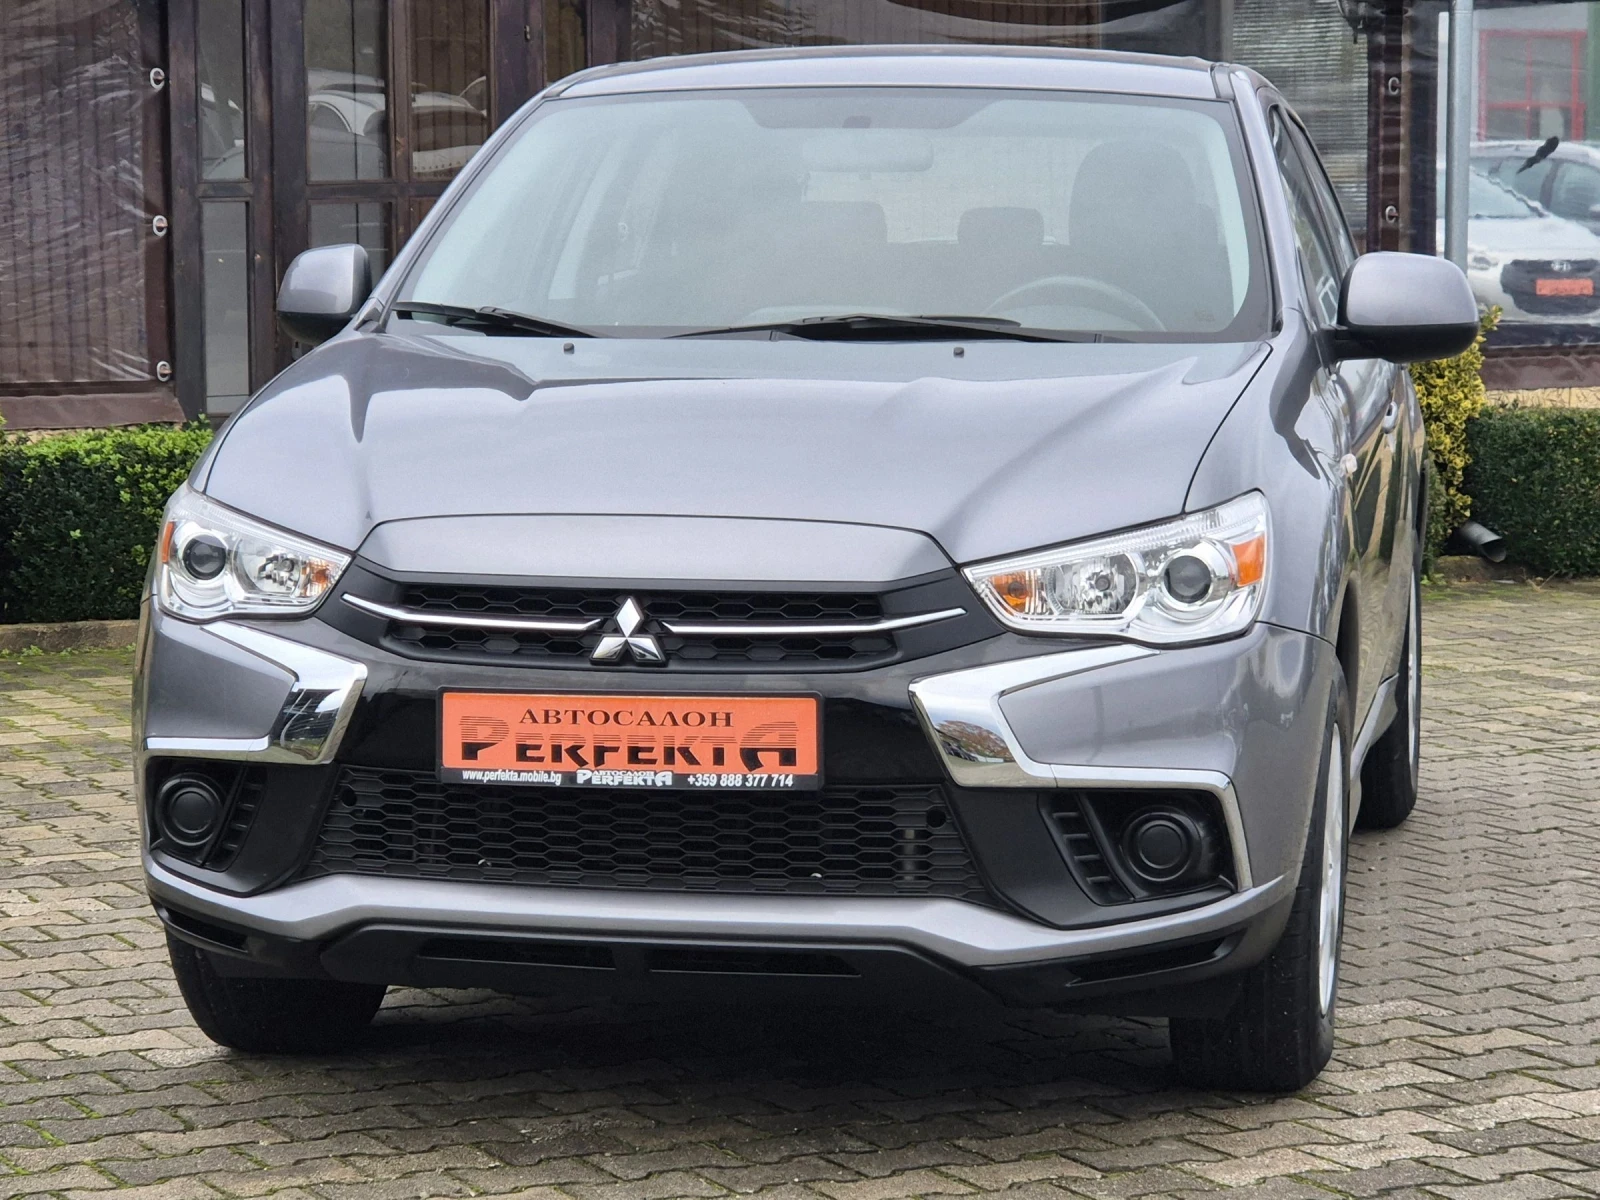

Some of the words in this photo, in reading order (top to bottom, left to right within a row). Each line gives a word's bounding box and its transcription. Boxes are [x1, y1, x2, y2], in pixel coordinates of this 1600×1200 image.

[519, 708, 734, 728] АВТОСАЛОН
[459, 715, 799, 772] PERFEKTA
[462, 769, 562, 785] www.perfekta.mobile.bg
[576, 769, 673, 787] PERFEKTA
[687, 774, 717, 787] +359
[720, 774, 742, 787] 888
[745, 774, 768, 787] 377
[771, 774, 793, 787] 714
